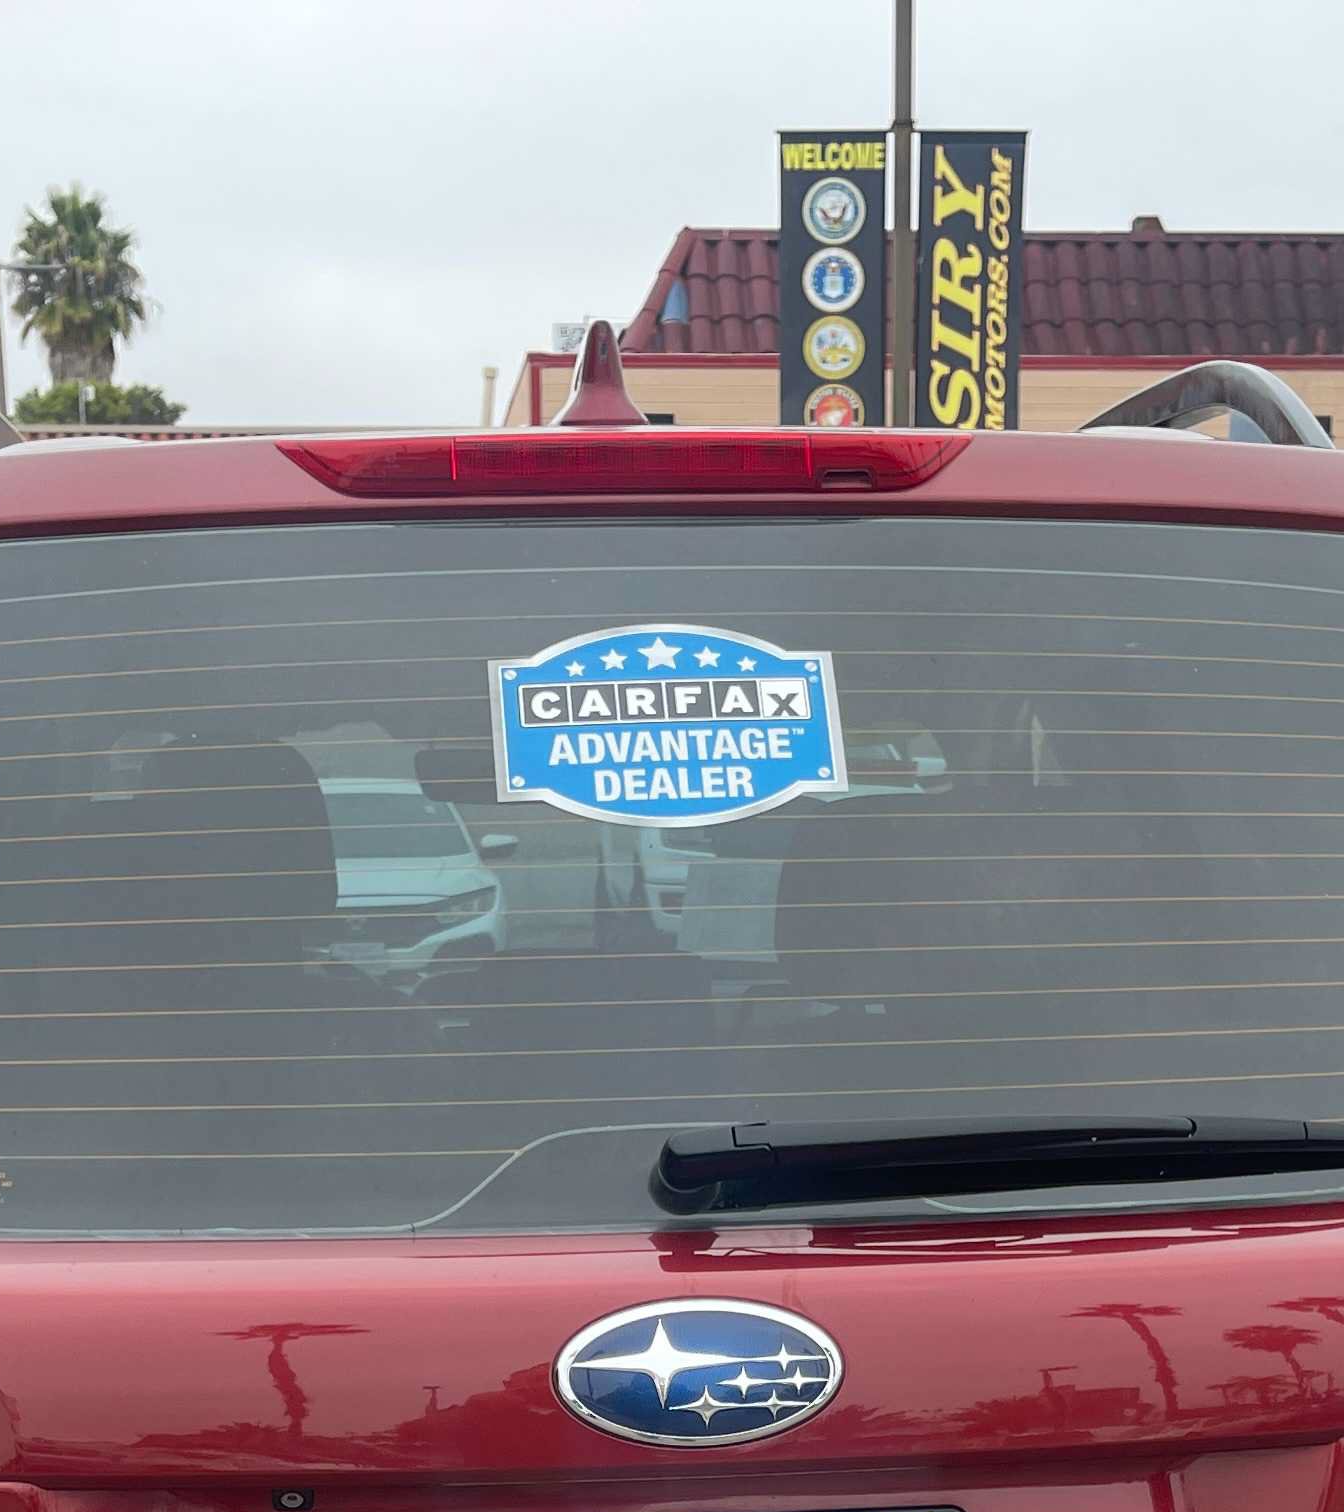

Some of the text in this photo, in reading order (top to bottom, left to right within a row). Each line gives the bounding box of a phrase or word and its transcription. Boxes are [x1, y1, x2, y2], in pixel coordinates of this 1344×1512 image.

[782, 142, 885, 171] WELCOME
[929, 144, 985, 429] SIRY
[984, 148, 1013, 430] MOTORS.COM
[530, 684, 803, 720] CARFAX
[594, 767, 755, 802] DEALER
